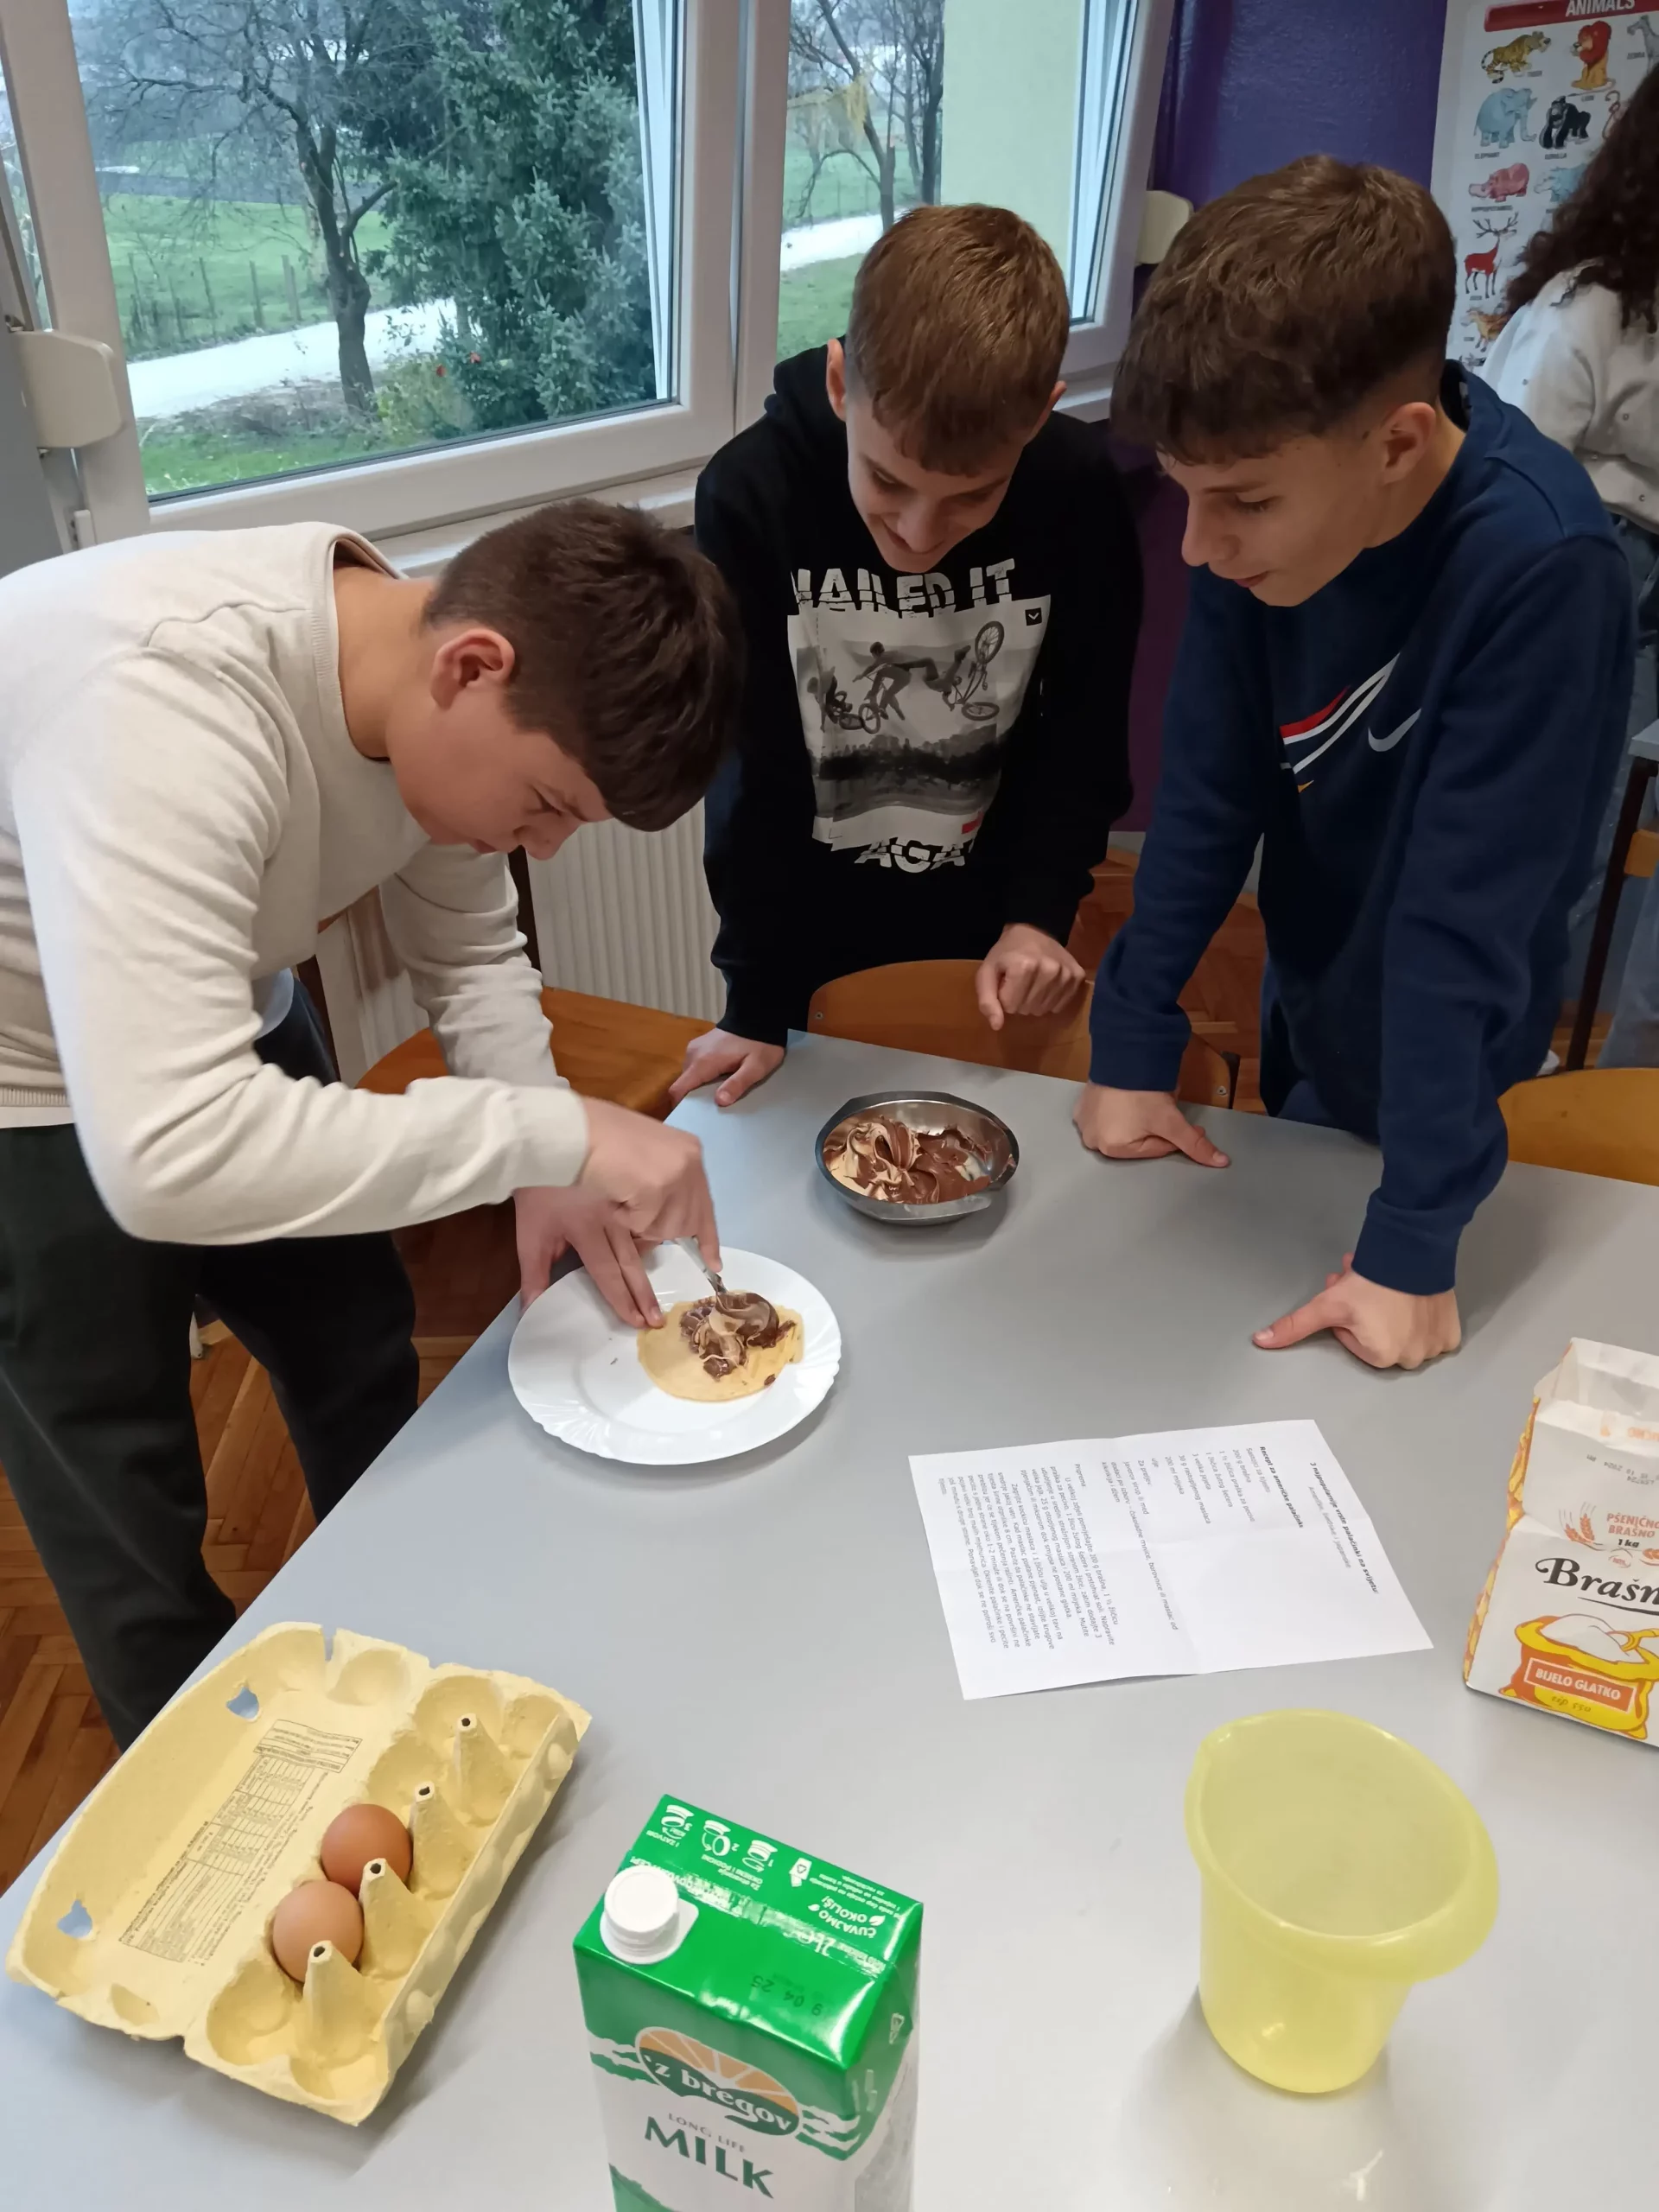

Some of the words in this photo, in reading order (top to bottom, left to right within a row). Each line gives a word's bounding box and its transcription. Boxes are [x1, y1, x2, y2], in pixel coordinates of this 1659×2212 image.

[1566, 0, 1635, 16] ANIMALS
[969, 557, 1015, 607] IT
[1258, 1446, 1273, 1465] Recept
[1273, 1474, 1290, 1501] američke
[1286, 1502, 1305, 1529] palačinke
[1311, 1467, 1338, 1508] najpopularnije
[1335, 1509, 1347, 1524] vrste
[1608, 1524, 1656, 1538] BRAŠNO
[1341, 1525, 1363, 1556] palačinki
[1357, 1558, 1366, 1567] na
[1361, 1568, 1380, 1594] svijetu:
[1535, 1667, 1573, 1688] BIJELO
[1575, 1680, 1622, 1701] GLATKO
[731, 1843, 741, 1852] 2
[818, 1910, 877, 1939] ČUVAJMO
[749, 1975, 774, 1993] 25
[681, 2069, 791, 2131] bregov
[668, 2112, 712, 2139] LONG
[718, 2135, 747, 2153] LIFE
[645, 2115, 774, 2199] MILK
